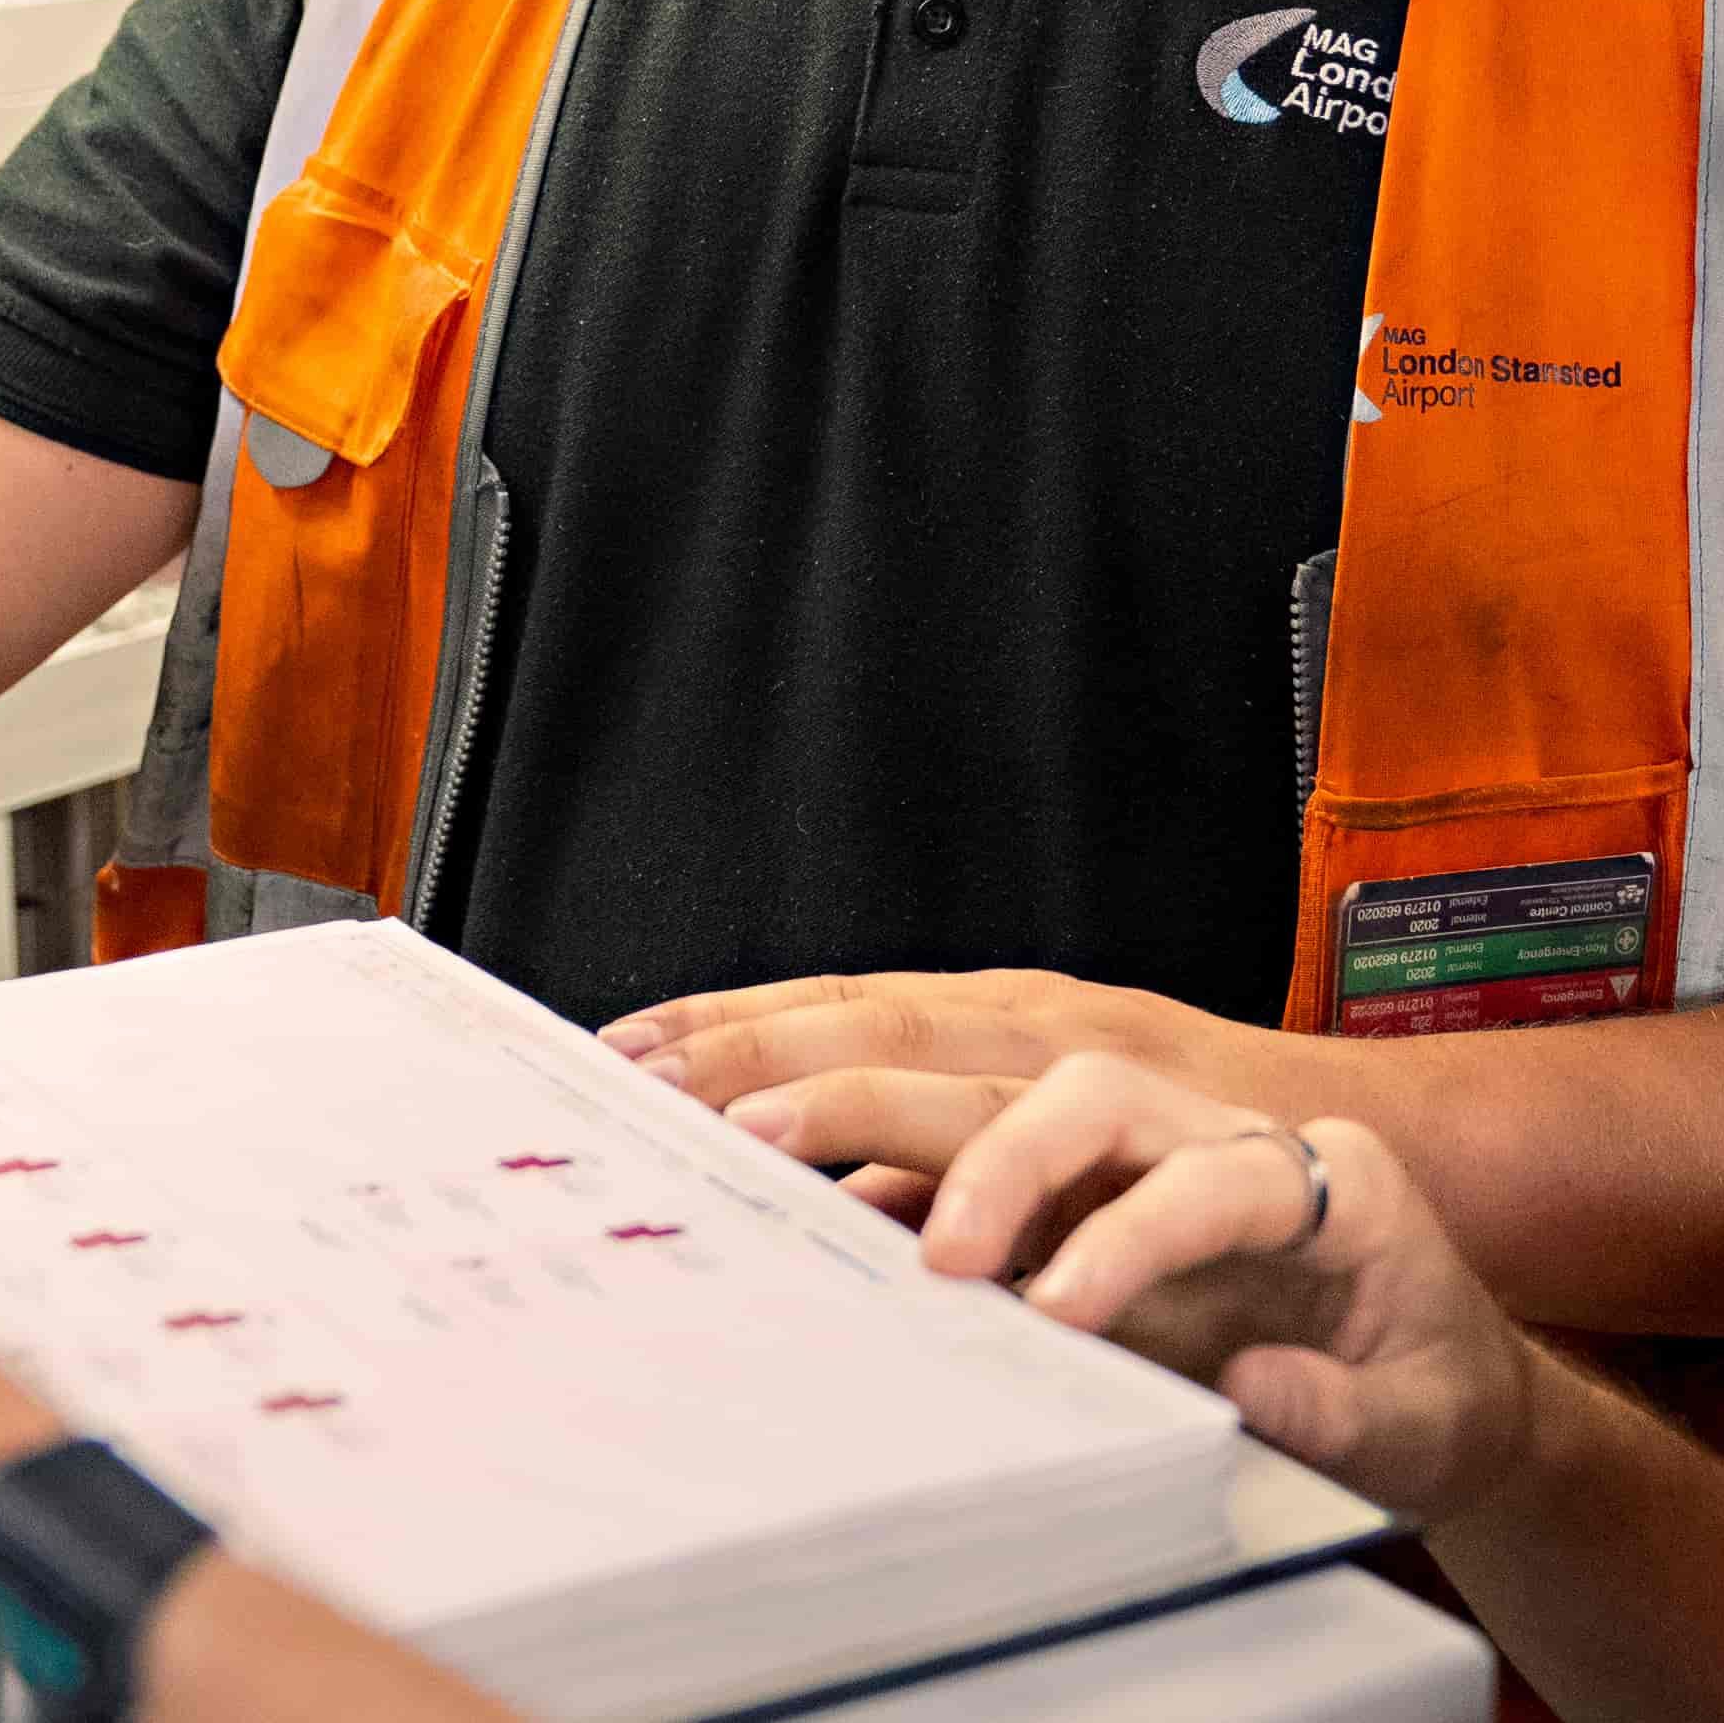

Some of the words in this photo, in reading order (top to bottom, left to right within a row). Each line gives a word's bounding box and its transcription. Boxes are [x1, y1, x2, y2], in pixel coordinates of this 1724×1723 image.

[1302, 23, 1380, 65] MAG
[1291, 47, 1398, 103] Lond
[1281, 82, 1388, 136] Airpo
[1382, 327, 1426, 346] MAG
[1382, 347, 1484, 379] London
[1490, 354, 1622, 388] Stansted
[1382, 378, 1476, 414] Airport
[1404, 900, 1441, 917] 01279
[1449, 895, 1489, 909] External
[1570, 900, 1613, 914] Control
[1357, 905, 1402, 922] 662020
[1451, 913, 1488, 926] Internal
[1529, 906, 1567, 917] Centre
[1410, 918, 1440, 933] 2020
[1400, 948, 1437, 964] 01279
[1445, 942, 1485, 956] External
[1517, 943, 1608, 961] Non-Emergency
[1407, 966, 1437, 981] 2020
[1541, 989, 1603, 1004] Emergency
